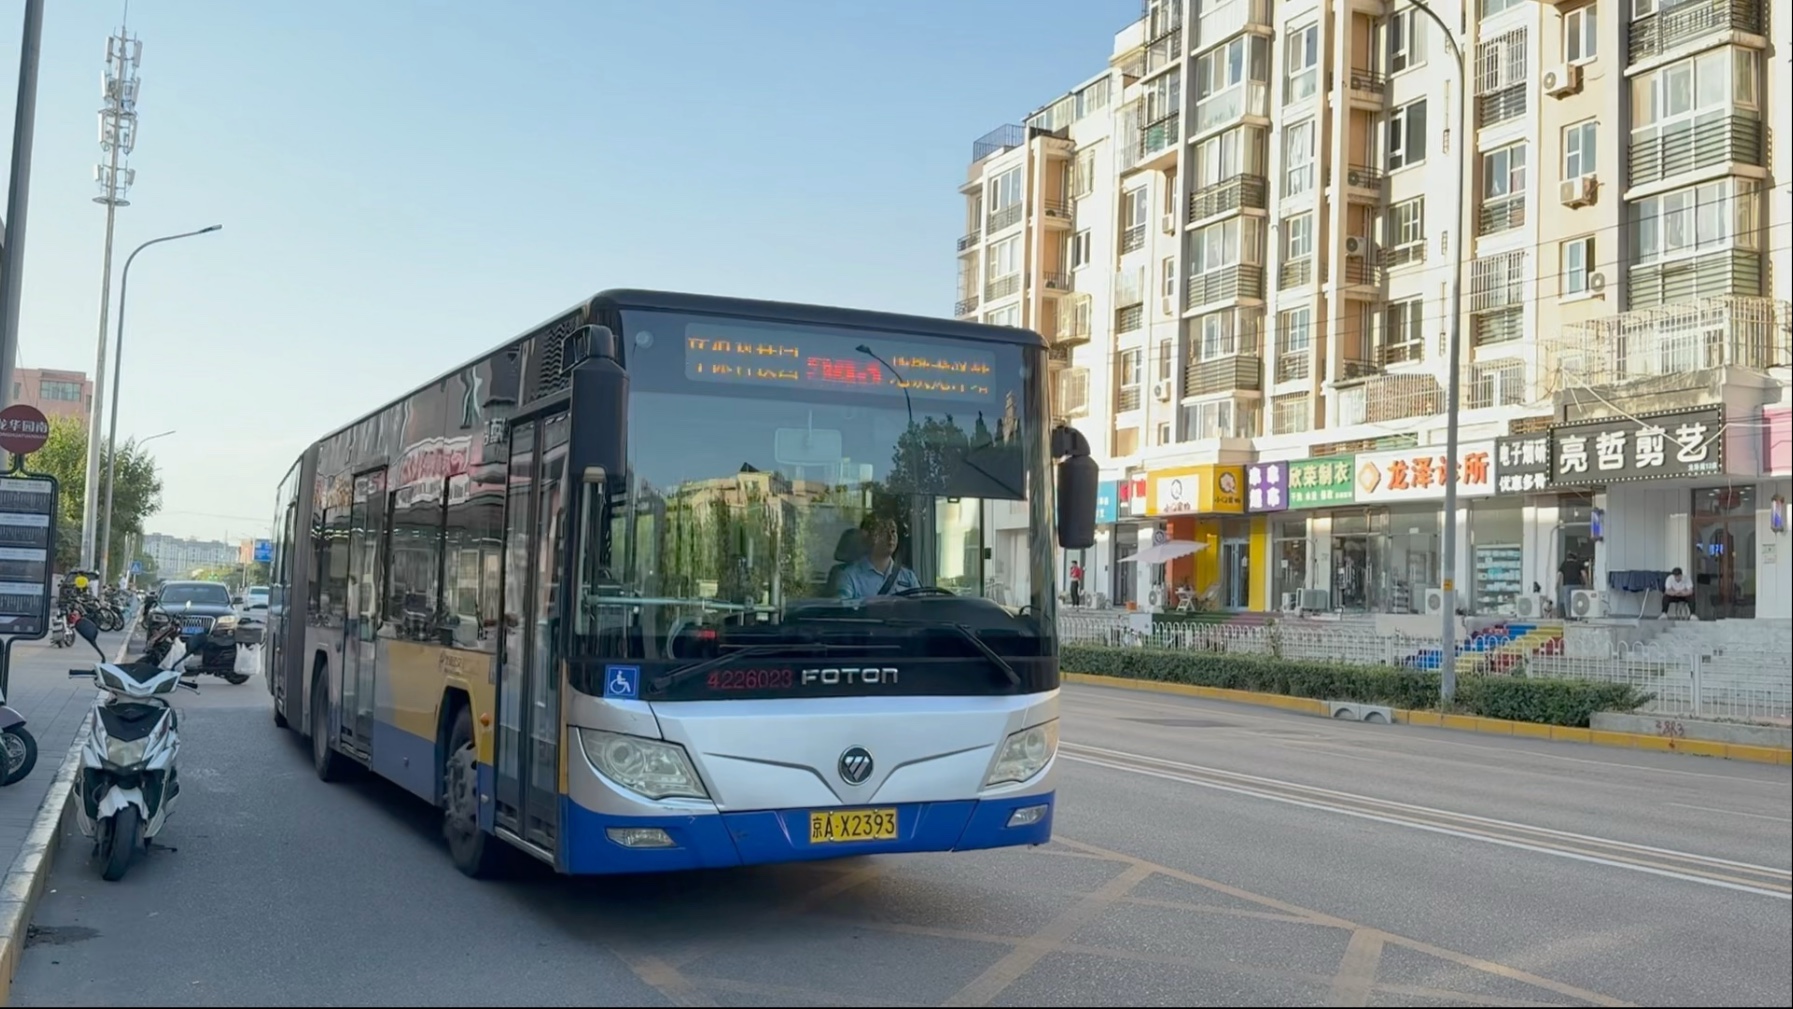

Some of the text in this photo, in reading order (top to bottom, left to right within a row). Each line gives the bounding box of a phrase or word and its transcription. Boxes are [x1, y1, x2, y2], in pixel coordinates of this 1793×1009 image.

[1559, 423, 1708, 474] 亮哲剪艺
[706, 669, 793, 690] 4226023
[801, 668, 898, 685] FOTON
